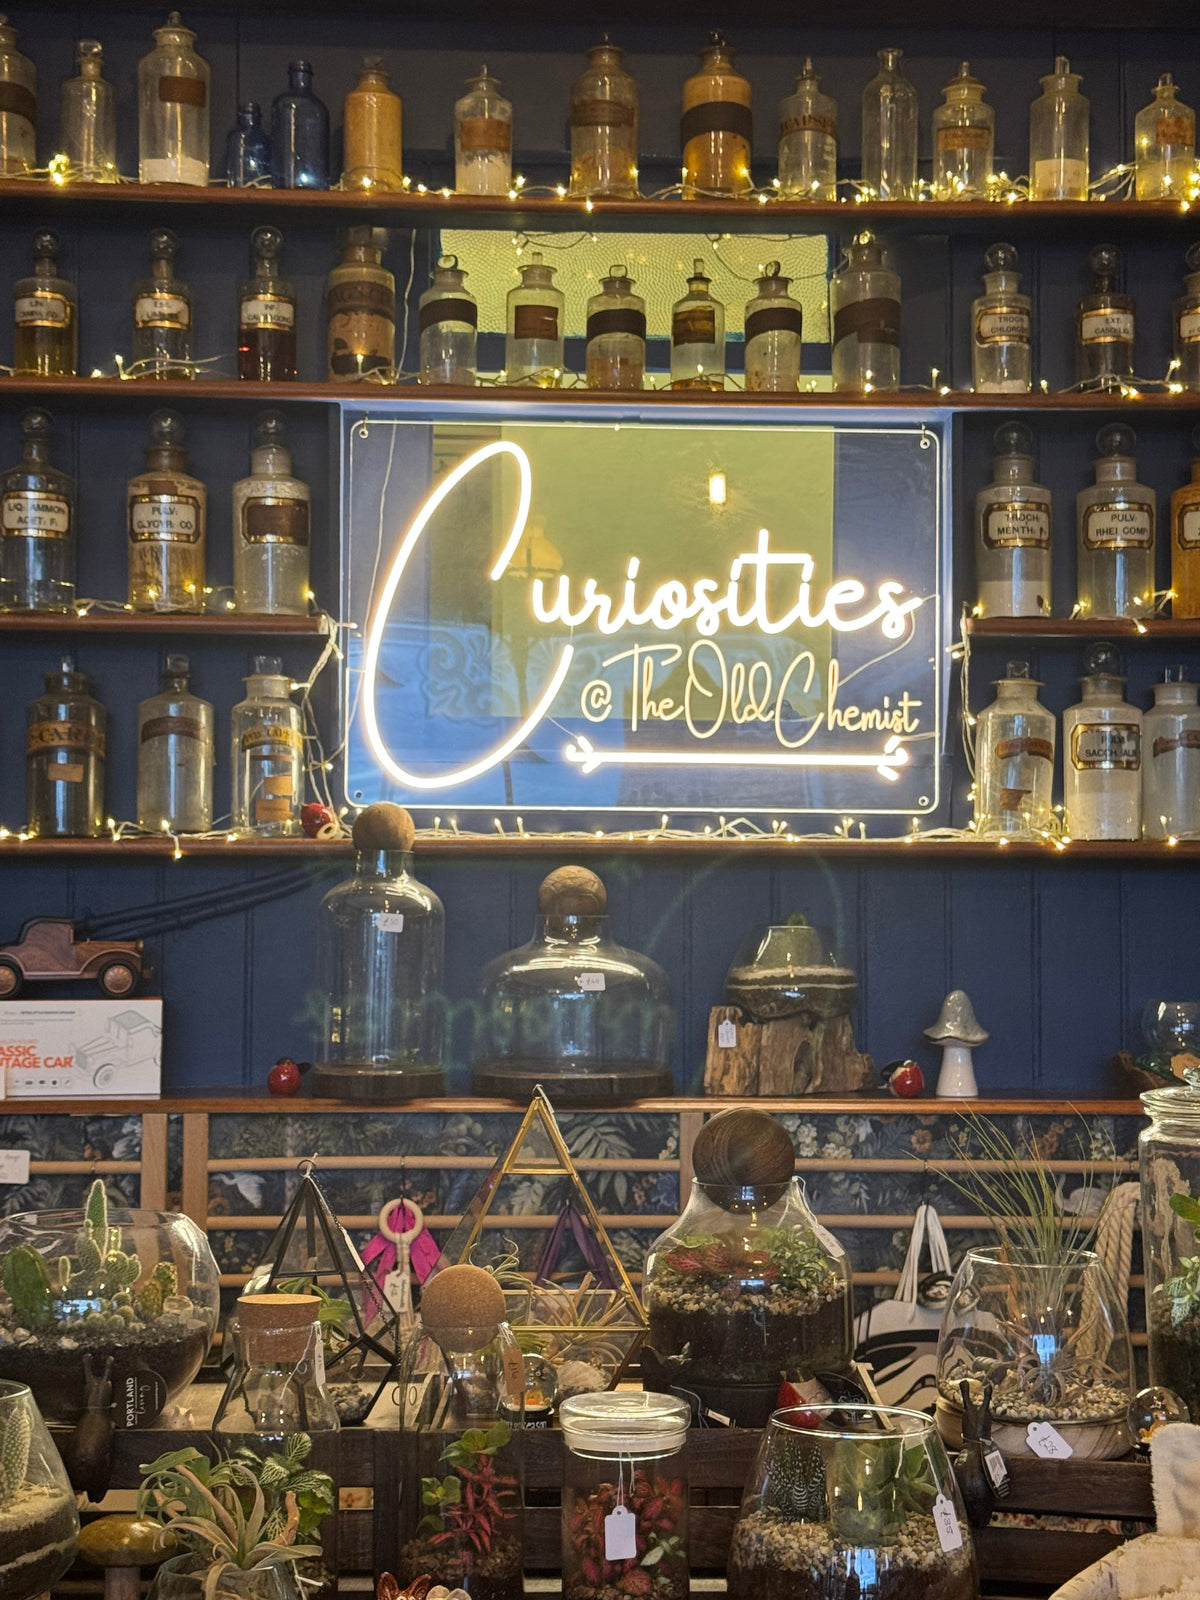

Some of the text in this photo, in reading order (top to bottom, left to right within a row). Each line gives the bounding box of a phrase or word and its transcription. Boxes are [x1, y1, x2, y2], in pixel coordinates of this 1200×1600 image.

[364, 440, 923, 789] Curiosities
[580, 639, 923, 748] @ The Old Chemist
[43, 1056, 73, 1069] CAR
[126, 1377, 135, 1428] PORTLAND
